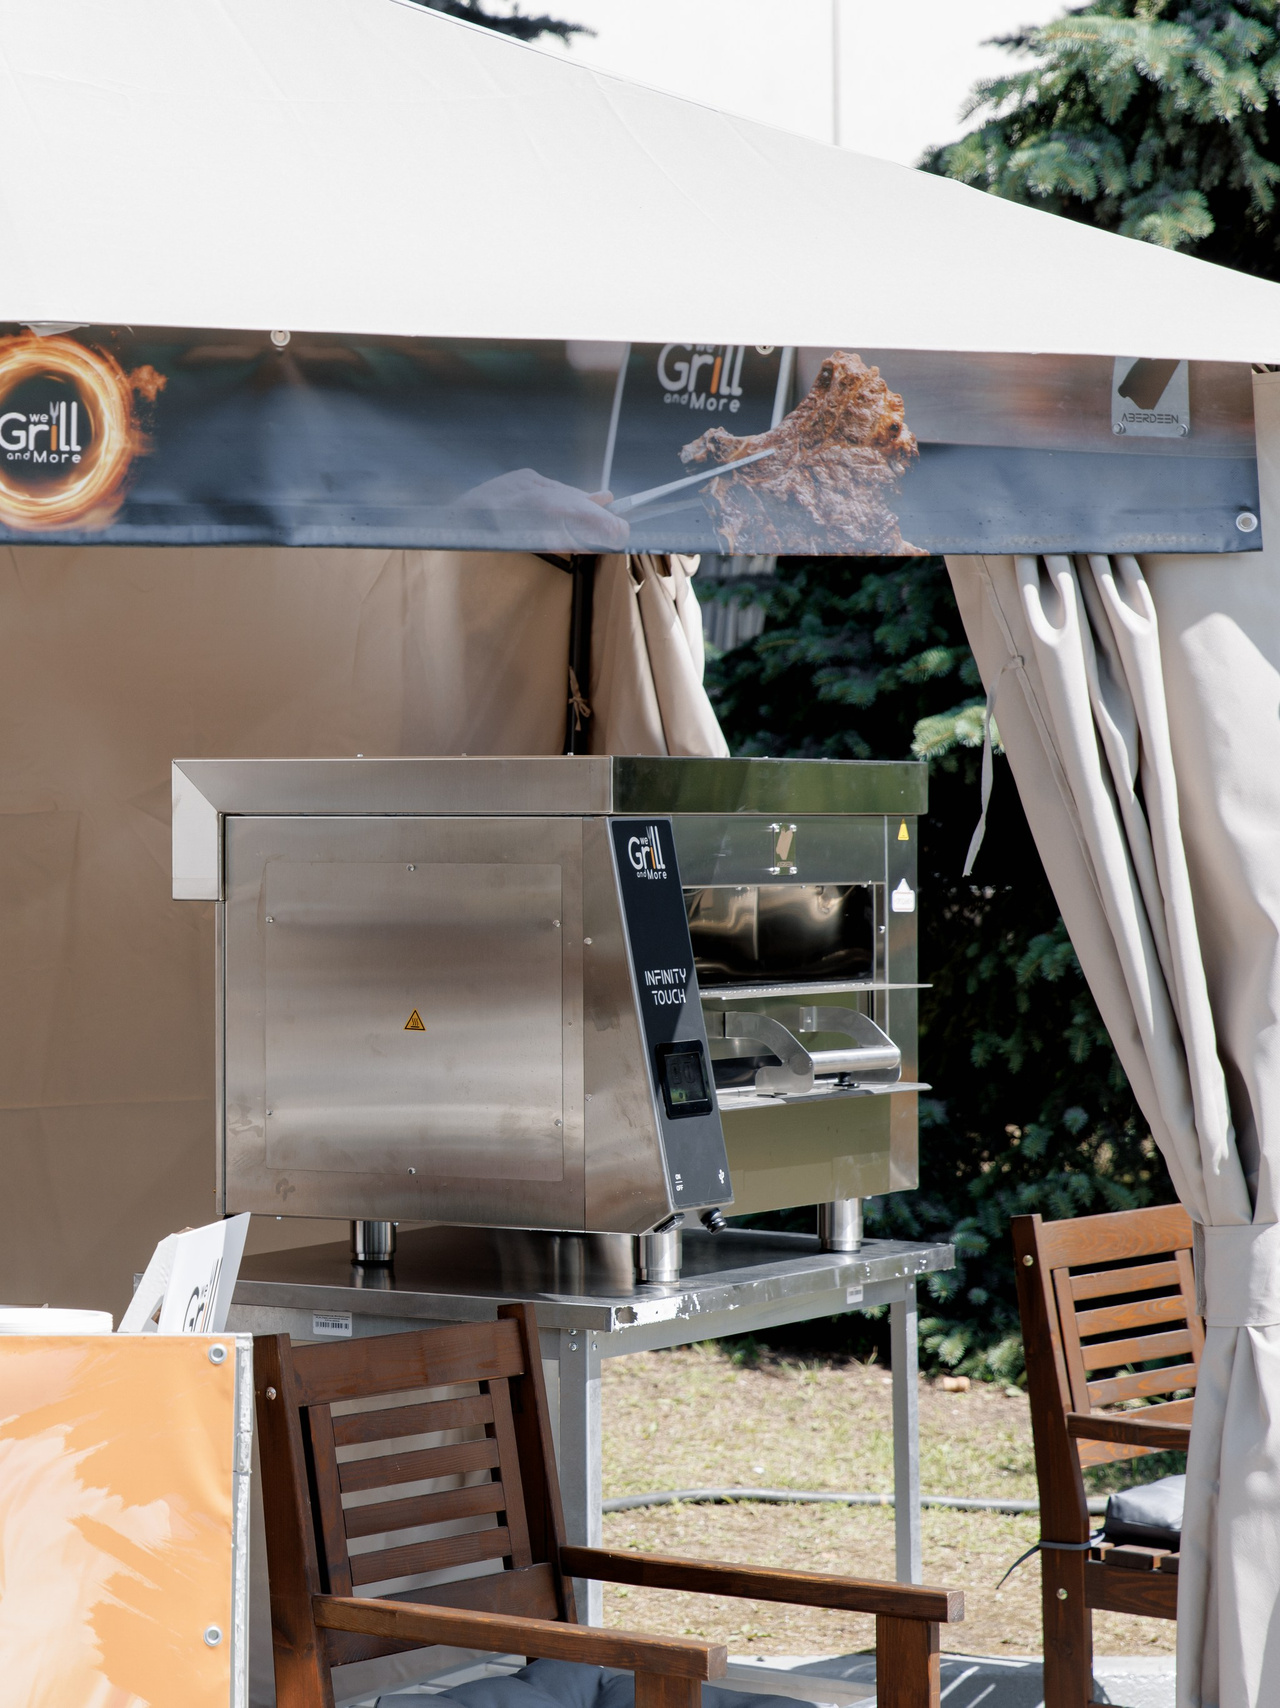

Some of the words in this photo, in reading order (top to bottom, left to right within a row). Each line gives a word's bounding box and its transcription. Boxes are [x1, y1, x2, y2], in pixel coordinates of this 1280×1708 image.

[657, 343, 745, 397] Grill
[663, 393, 689, 405] and
[689, 392, 741, 413] More
[29, 413, 49, 422] we
[1121, 412, 1179, 424] ABERDEEN
[7, 451, 30, 460] and
[33, 450, 82, 463] More
[628, 825, 666, 870] Grill
[640, 837, 649, 845] we
[636, 870, 647, 878] and
[647, 869, 667, 880] More
[644, 968, 687, 986] INFINITY
[651, 989, 687, 1006] TOUCH
